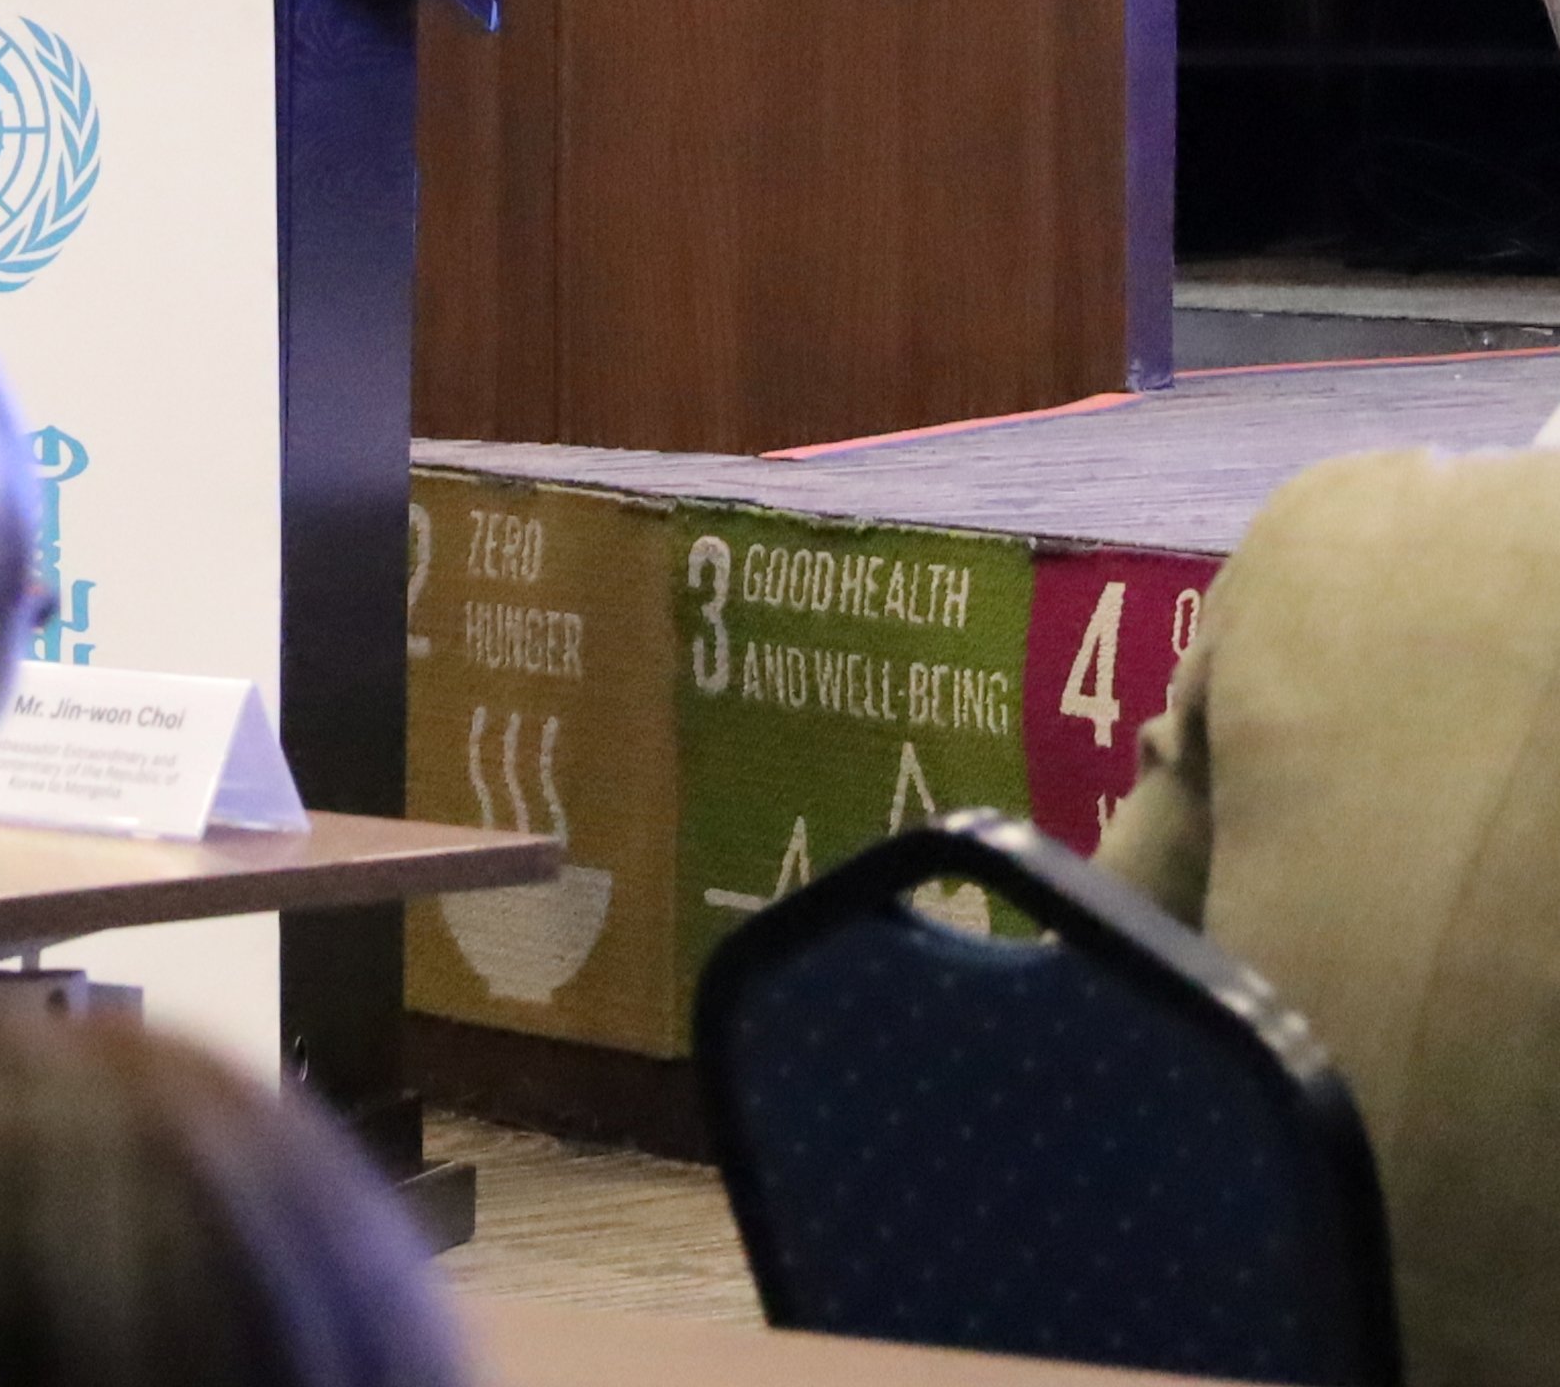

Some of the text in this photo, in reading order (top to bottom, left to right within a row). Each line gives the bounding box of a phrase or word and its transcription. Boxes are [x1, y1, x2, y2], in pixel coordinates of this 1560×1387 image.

[468, 509, 543, 582] ZERO
[742, 543, 971, 629] GOOD HEALTH
[465, 601, 584, 679] HUNGER
[688, 535, 731, 694] 3
[741, 641, 1009, 735] AND WELL-BEING
[1060, 581, 1126, 748] 4
[14, 694, 186, 730] Mr. Jin-won Choi
